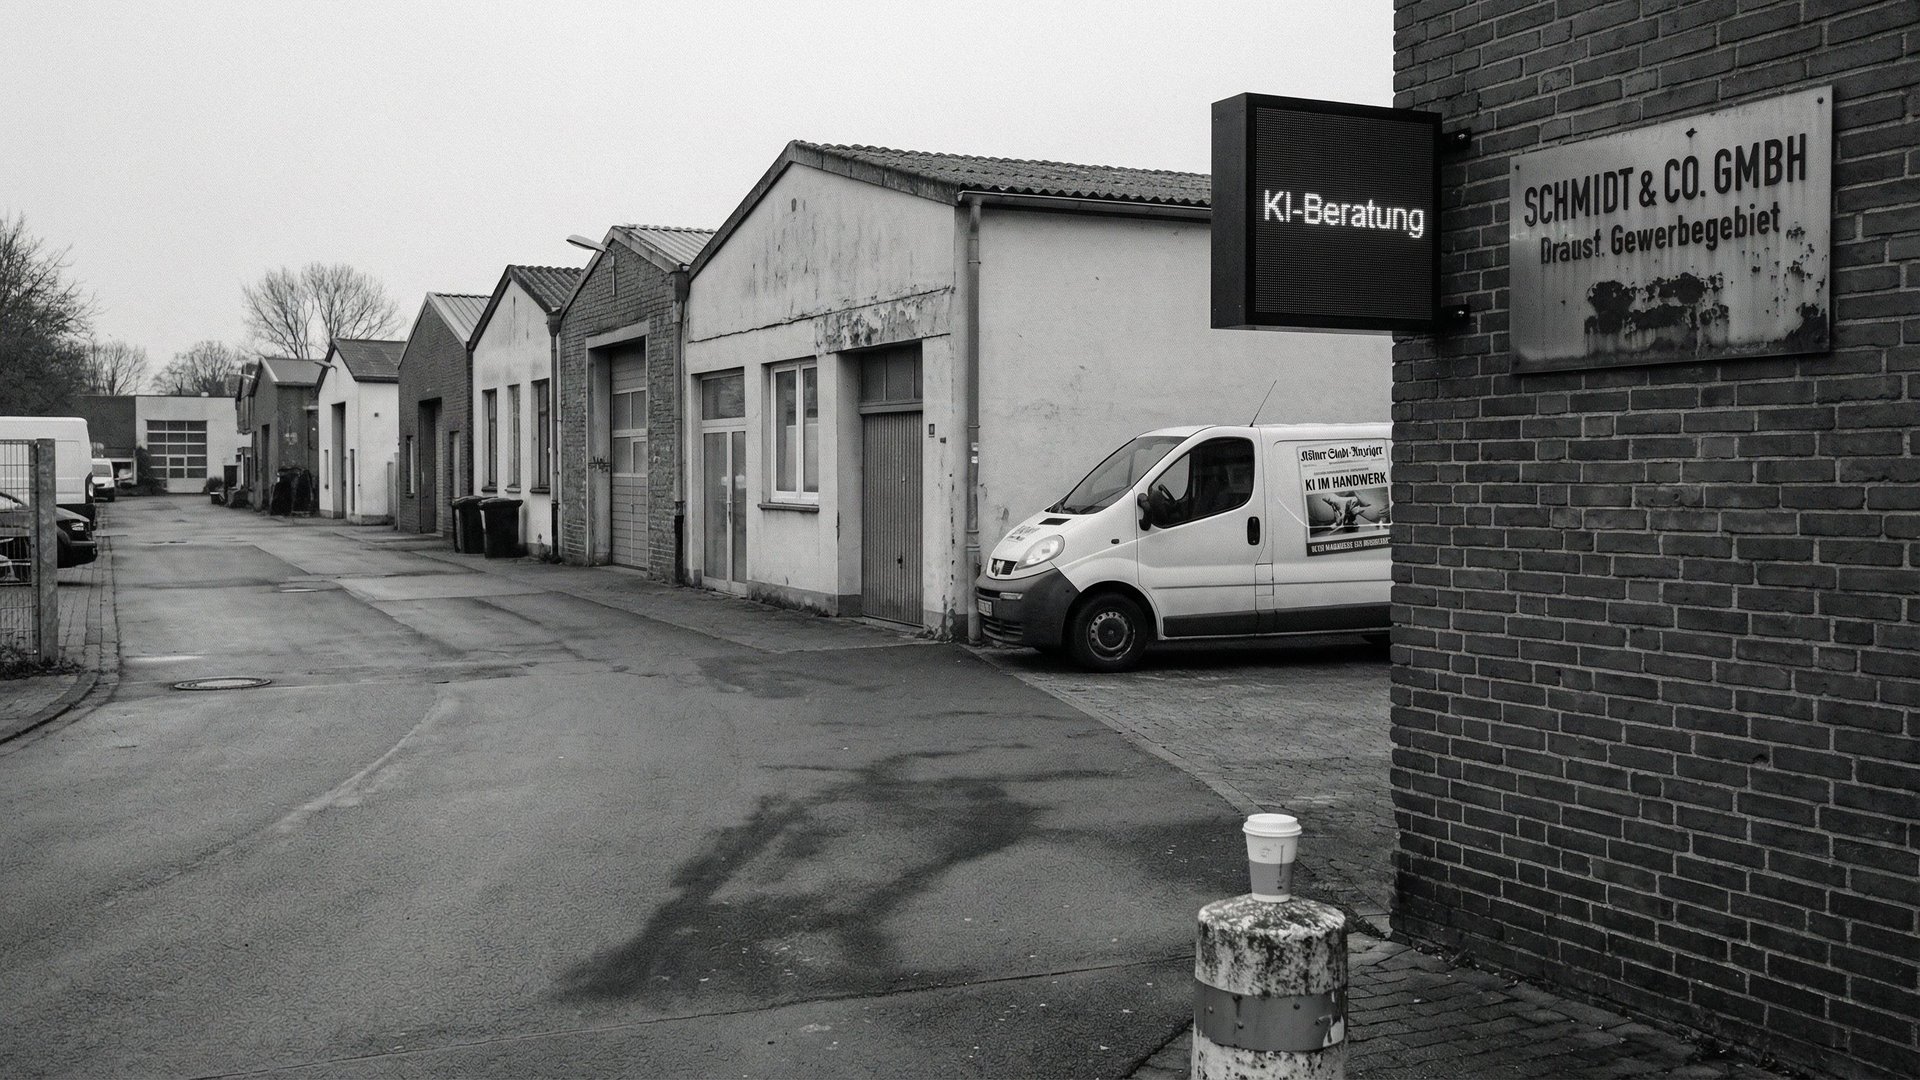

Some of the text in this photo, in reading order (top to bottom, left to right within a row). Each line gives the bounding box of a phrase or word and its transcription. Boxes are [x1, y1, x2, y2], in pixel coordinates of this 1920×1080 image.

[1524, 133, 1806, 227] SCHMIDT & CO. GMBH
[1264, 189, 1424, 239] KI-Beratung
[1611, 202, 1781, 256] Gewerbegebiet
[1305, 477, 1316, 491] KI
[1318, 475, 1330, 490] IM
[1332, 471, 1387, 488] HANDWERK
